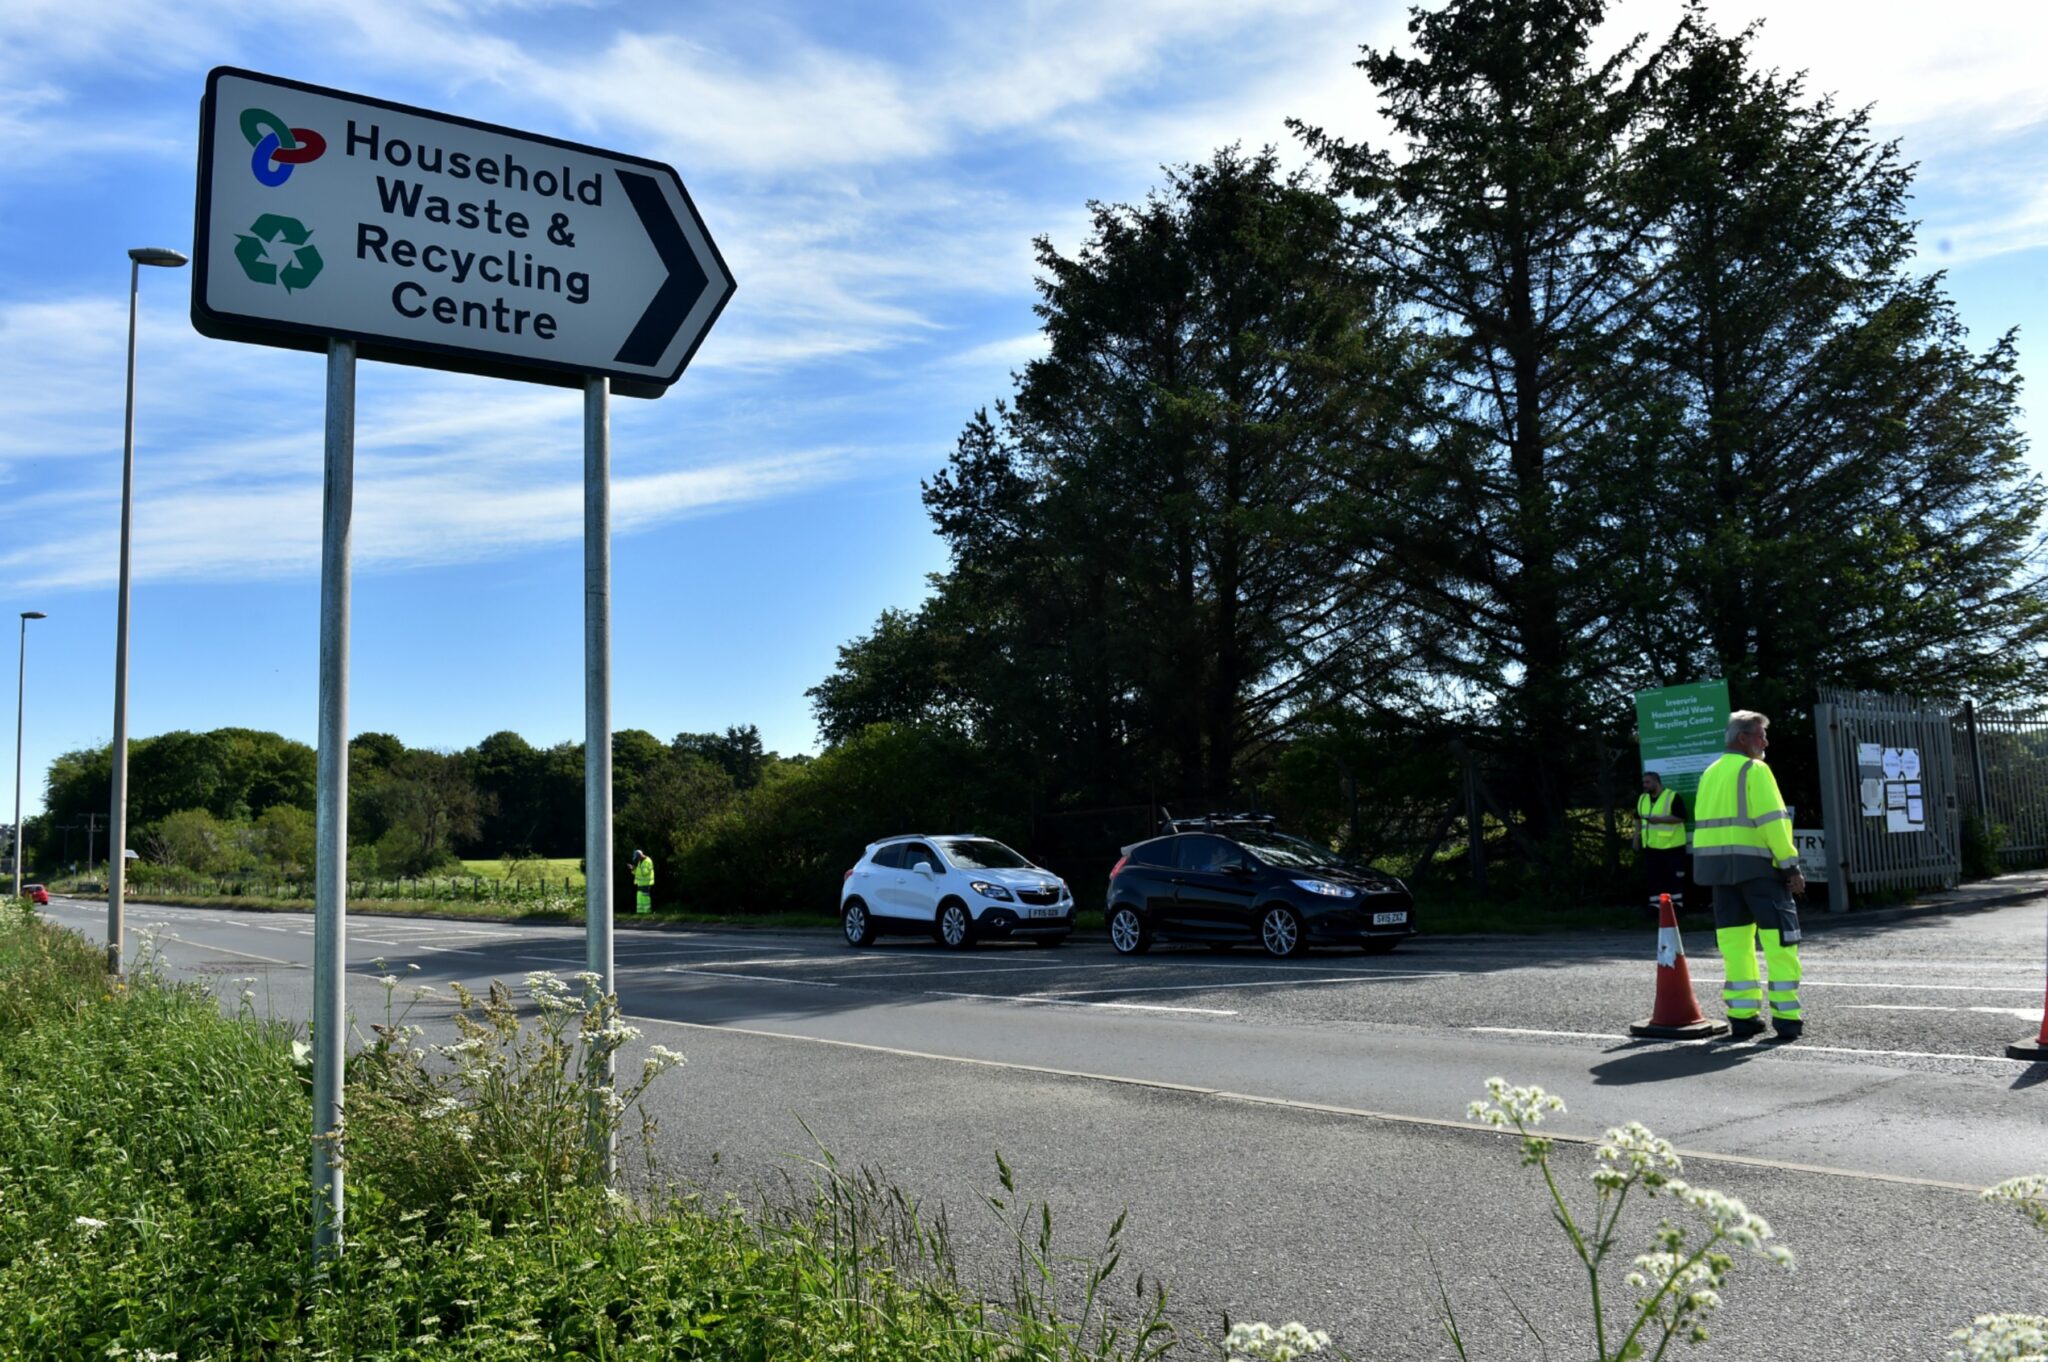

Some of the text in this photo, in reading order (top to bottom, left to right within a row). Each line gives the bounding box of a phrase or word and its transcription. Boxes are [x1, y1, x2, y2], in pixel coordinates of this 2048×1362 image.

[345, 120, 602, 206] Household
[376, 176, 576, 248] Waste &
[356, 222, 590, 304] Recycling
[392, 281, 558, 340] Centre
[1651, 705, 1714, 719] Household Waste
[1654, 716, 1714, 729] Recycling Centre
[1794, 836, 1825, 849] TRY
